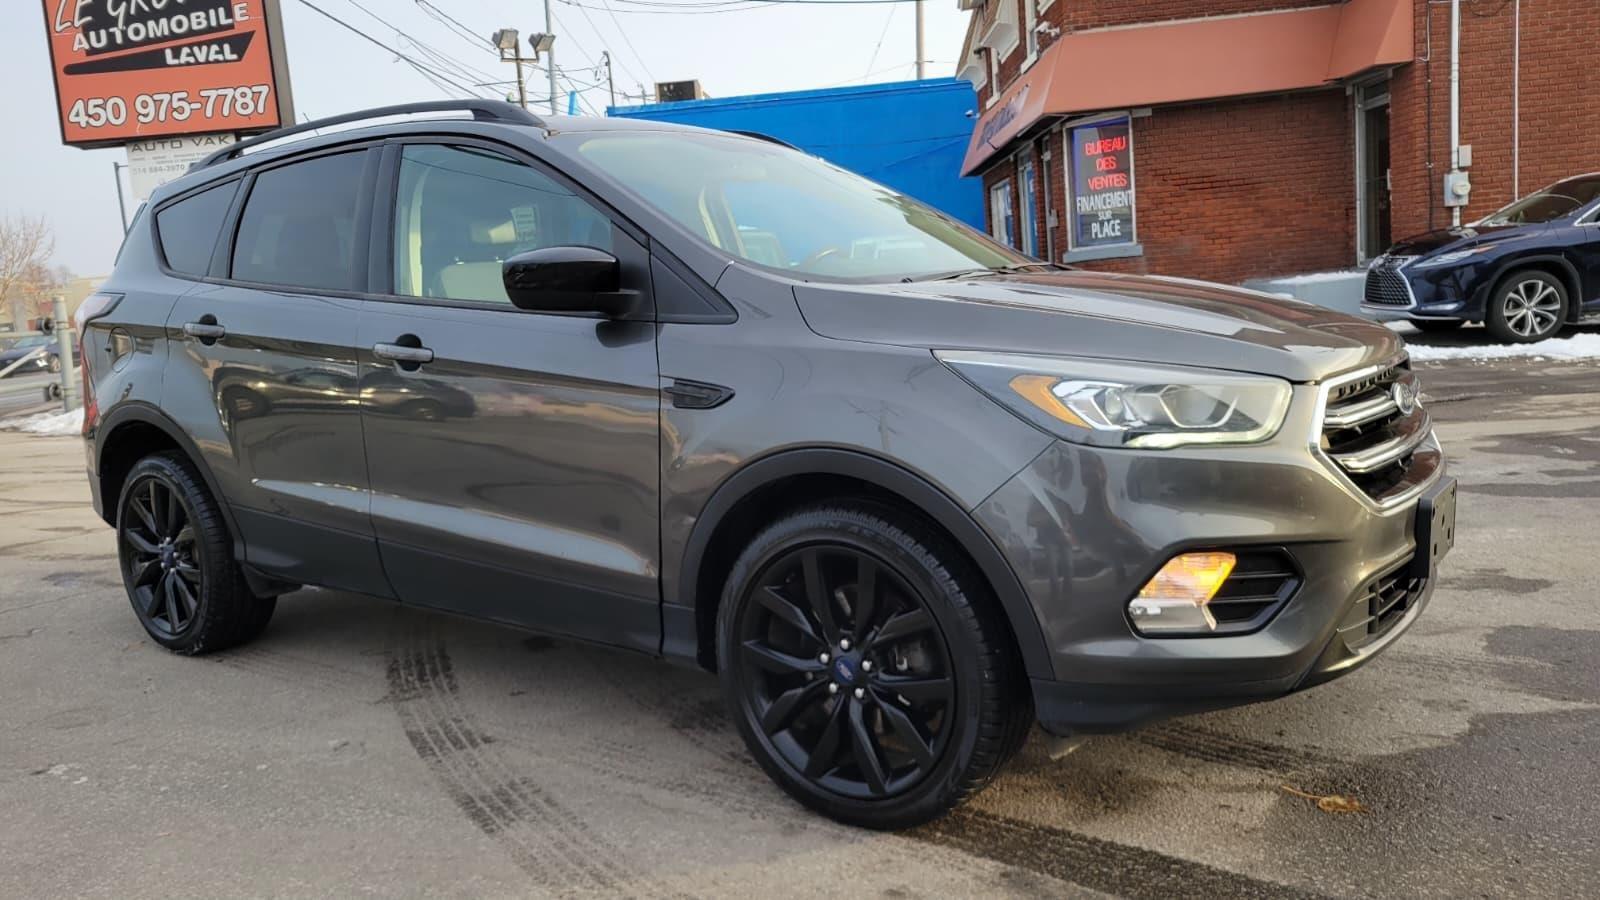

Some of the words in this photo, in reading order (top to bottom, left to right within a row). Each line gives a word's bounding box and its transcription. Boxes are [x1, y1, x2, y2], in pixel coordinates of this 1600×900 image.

[72, 2, 250, 51] AUTOMOBILE
[164, 43, 238, 66] LAVAL
[68, 97, 127, 128] 450
[134, 84, 270, 124] 975-7787
[131, 139, 183, 153] AUTO
[191, 135, 230, 147] VAK
[1084, 136, 1126, 156] BUREAU
[1095, 155, 1117, 172] DES
[1087, 173, 1128, 191] VENTES
[1076, 190, 1133, 213] FINANCEMENT
[1098, 210, 1113, 221] SUR
[1091, 219, 1122, 239] PLACE
